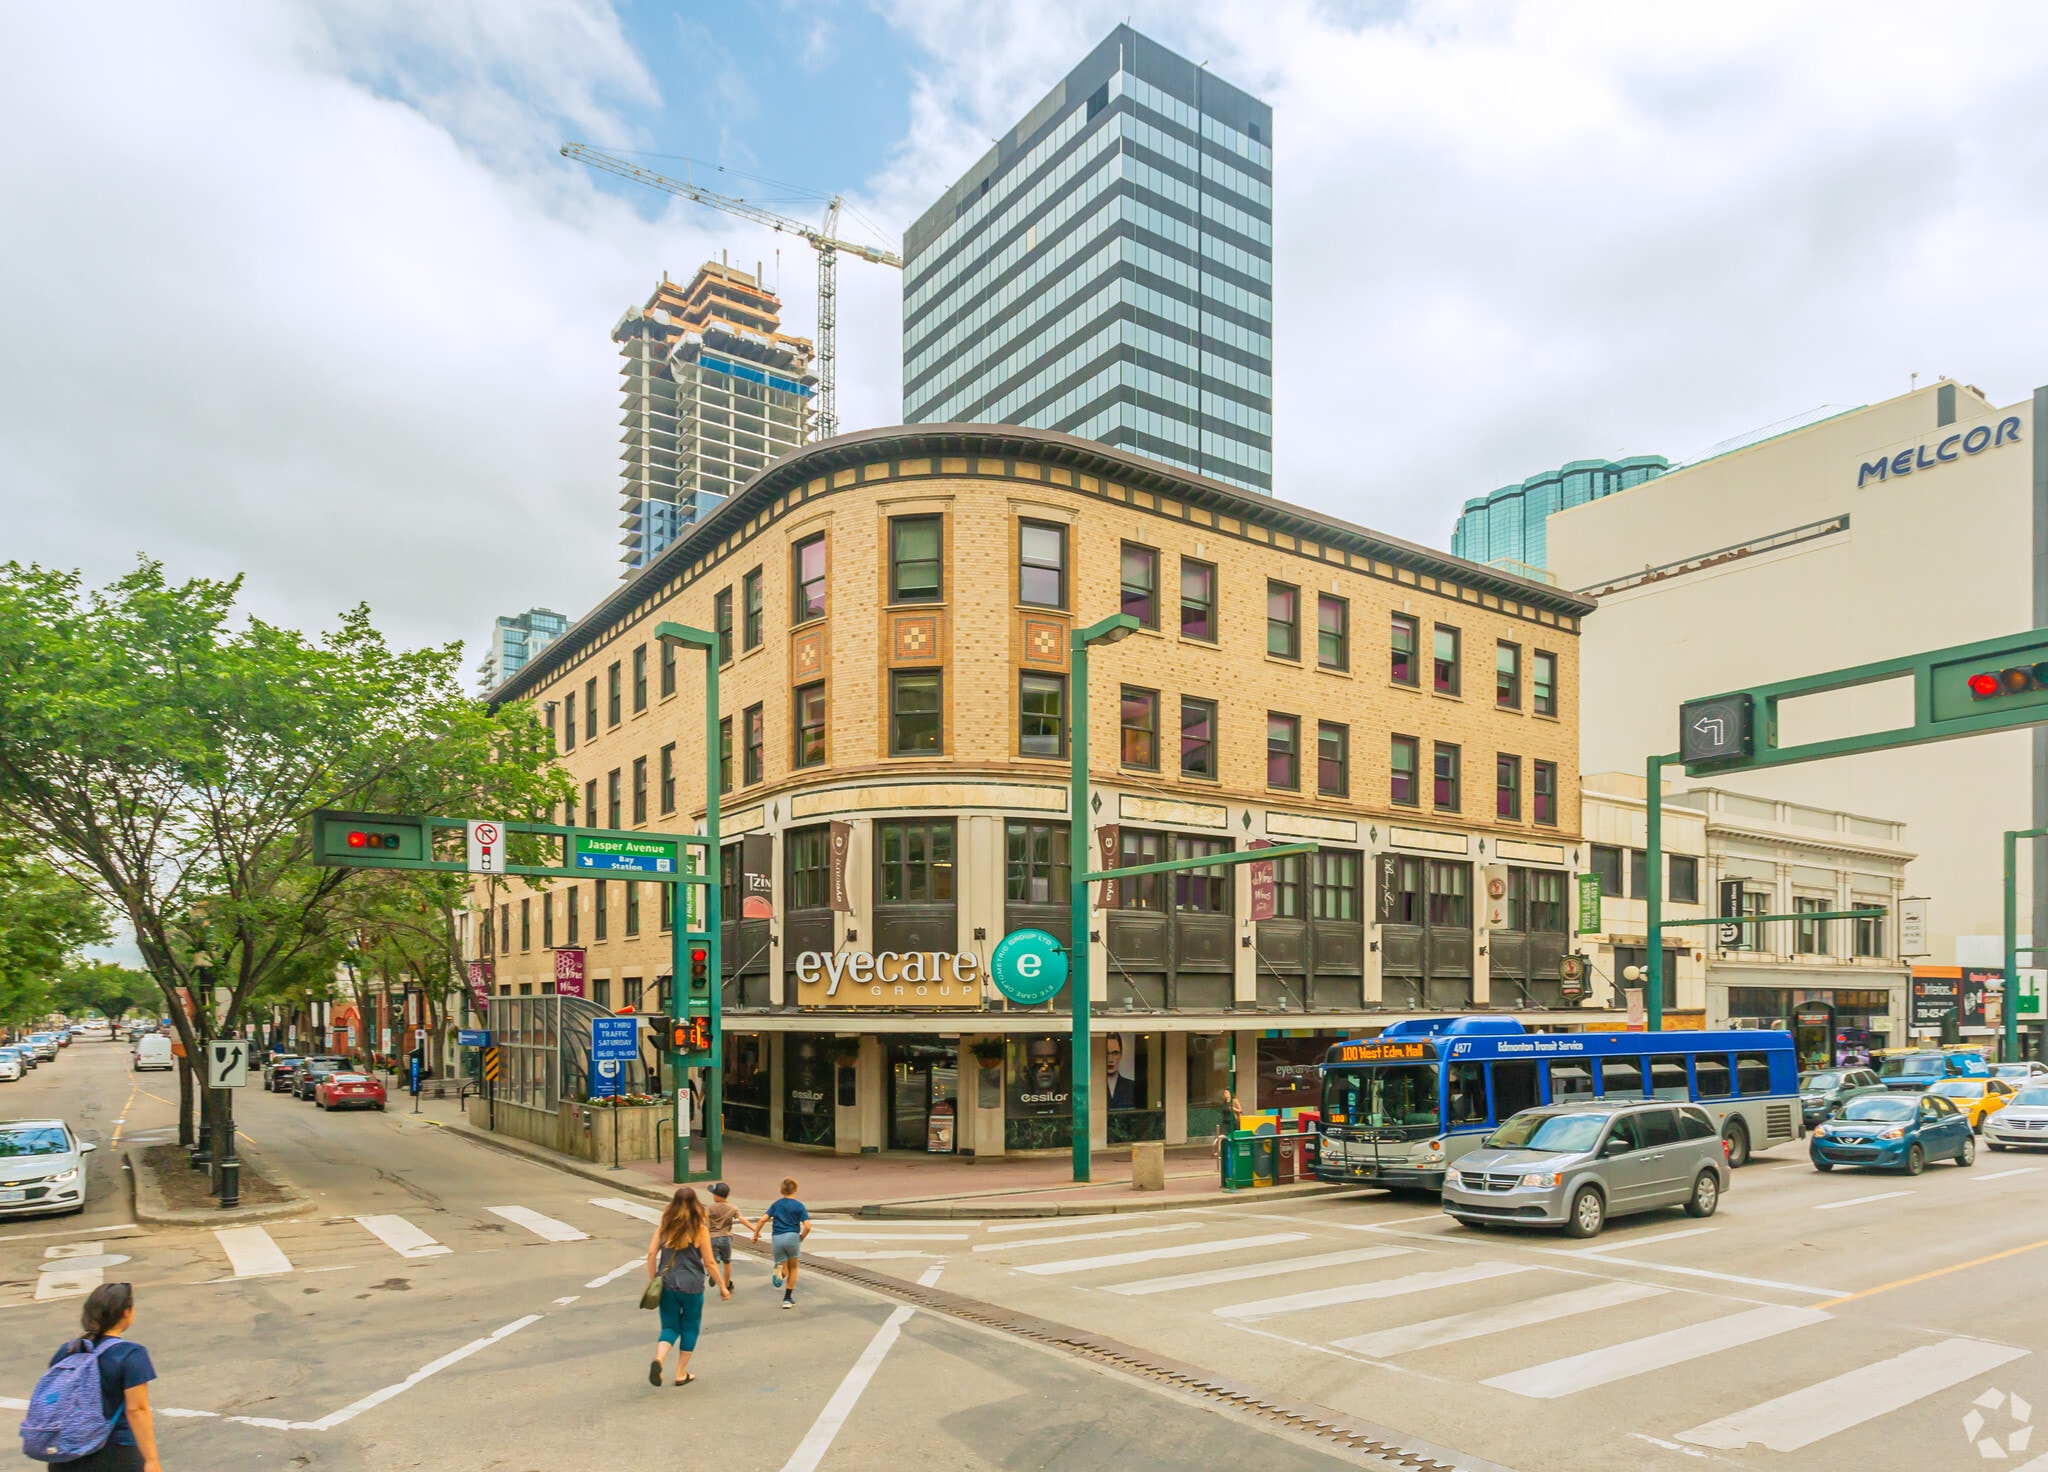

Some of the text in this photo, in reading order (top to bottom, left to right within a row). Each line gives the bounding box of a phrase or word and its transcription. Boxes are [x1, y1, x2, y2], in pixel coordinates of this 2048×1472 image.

[1857, 416, 2021, 488] MELCOR
[588, 840, 665, 853] Jasper Avenue
[611, 862, 642, 871] Station
[619, 855, 634, 866] Bay
[1582, 882, 1590, 929] FOR LEASE
[996, 934, 1054, 999] EYE CARE OPTOMETRIC GROUP LTD
[1016, 953, 1042, 978] e
[795, 950, 979, 996] eyecare
[871, 985, 972, 996] GROUP
[601, 1030, 629, 1038] TRAFFIC
[1342, 1043, 1423, 1061] 100 West Edm. Mall
[1454, 1042, 1472, 1054] 4877
[1497, 1040, 1584, 1052] Edmonton Transit Service
[792, 1089, 824, 1101] essilor
[1021, 1092, 1068, 1102] essilor
